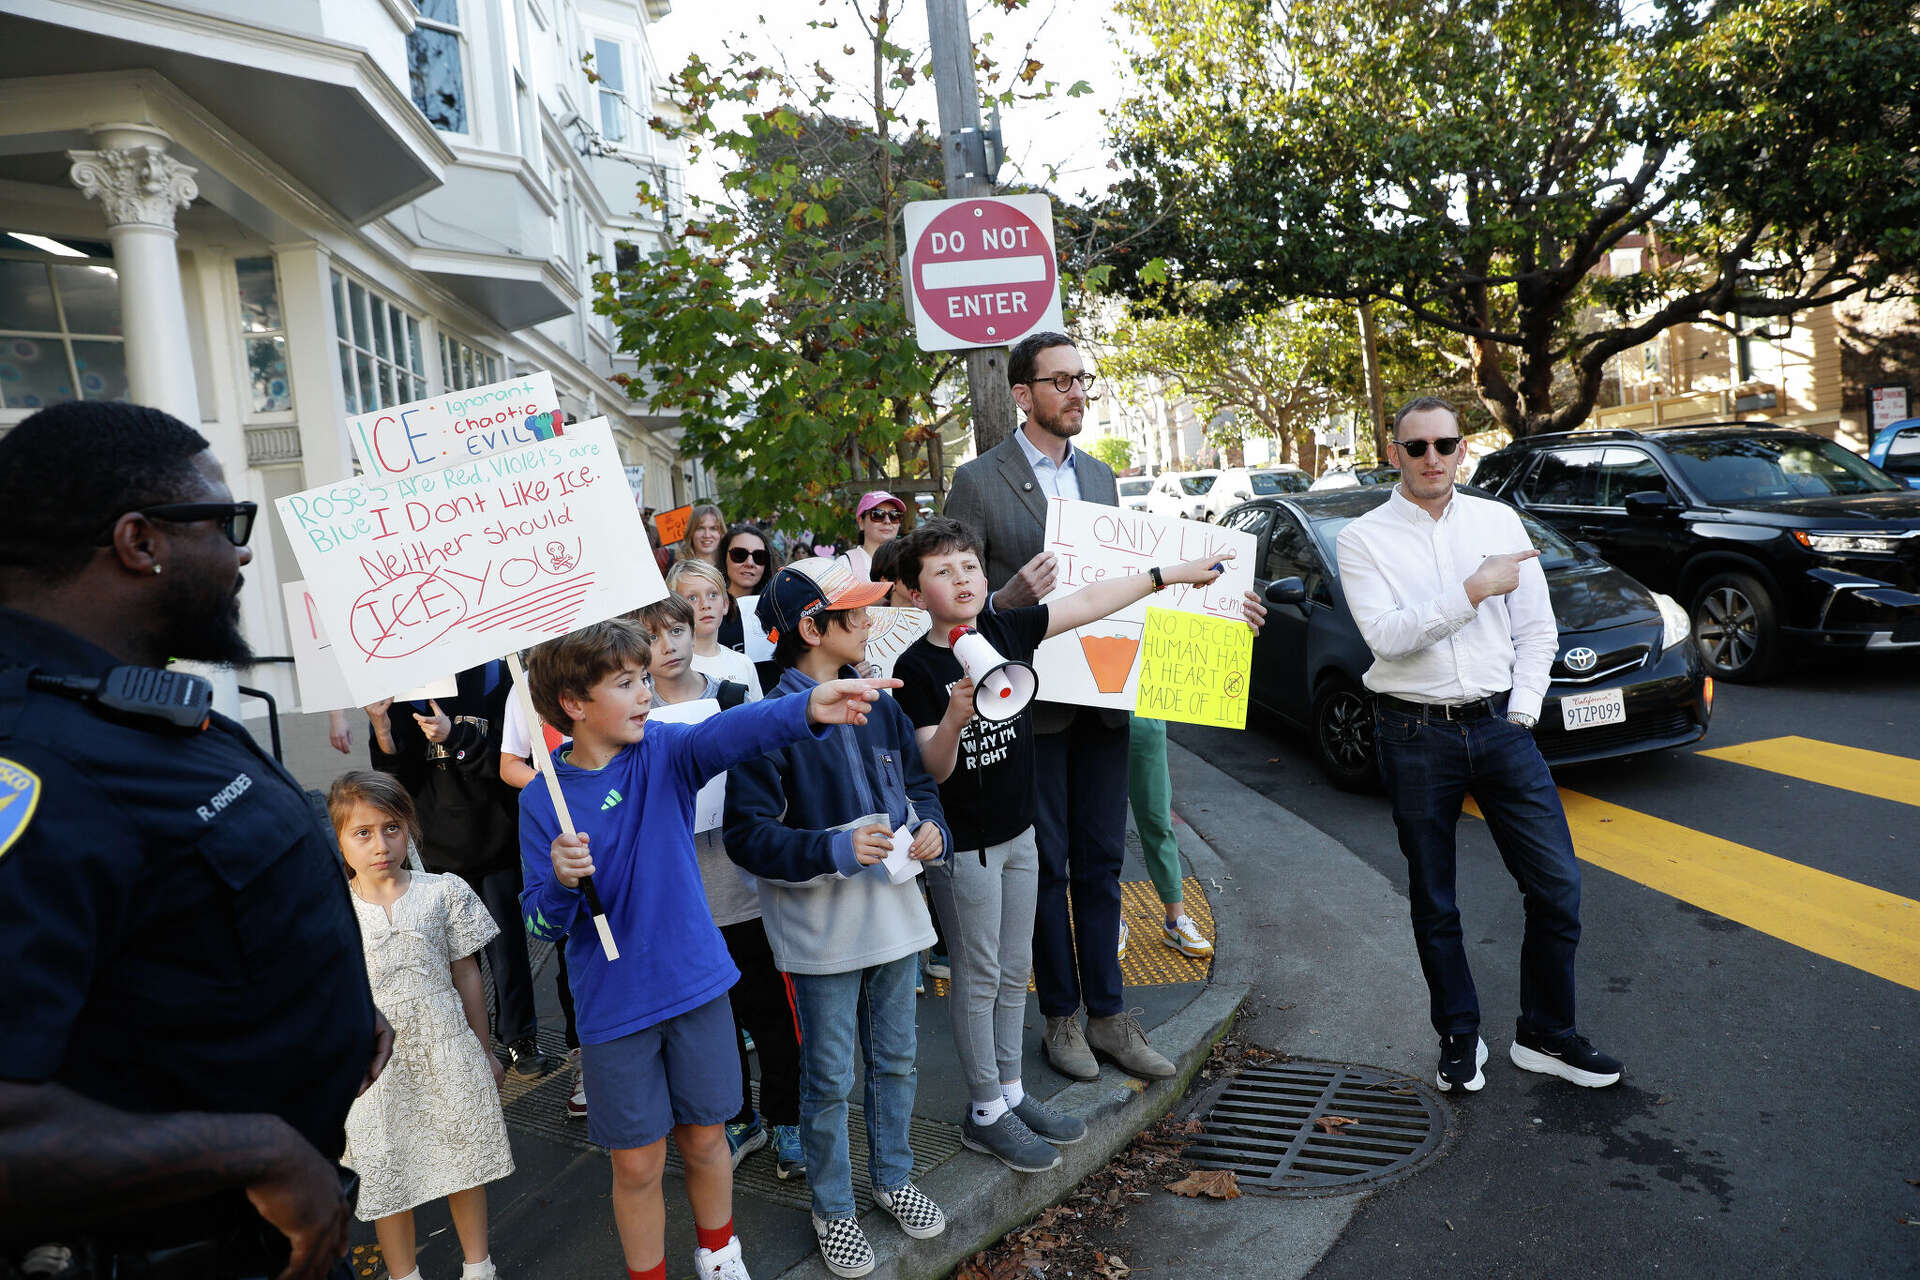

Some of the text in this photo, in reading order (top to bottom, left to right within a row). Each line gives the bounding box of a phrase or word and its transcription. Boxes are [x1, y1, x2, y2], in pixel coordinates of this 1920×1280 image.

[931, 226, 1030, 255] DO NOT
[947, 291, 1029, 319] ENTER
[445, 382, 535, 416] Ignorant
[466, 426, 532, 455] EVIL
[308, 517, 371, 552] Blue
[370, 507, 399, 541] I
[1051, 497, 1075, 548] I
[360, 533, 473, 586] Neither
[444, 536, 582, 606] YOU
[1148, 613, 1254, 648] NO DECENT
[1143, 634, 1249, 674] HUMAN HAS
[1139, 659, 1220, 689] A HEART
[1139, 683, 1246, 724] MADE OF ICE
[1567, 702, 1621, 725] 9TZP099
[961, 733, 997, 753] WHY
[999, 726, 1017, 744] I'M
[965, 746, 1008, 770] RGHT
[196, 772, 253, 822] R. RHODES
